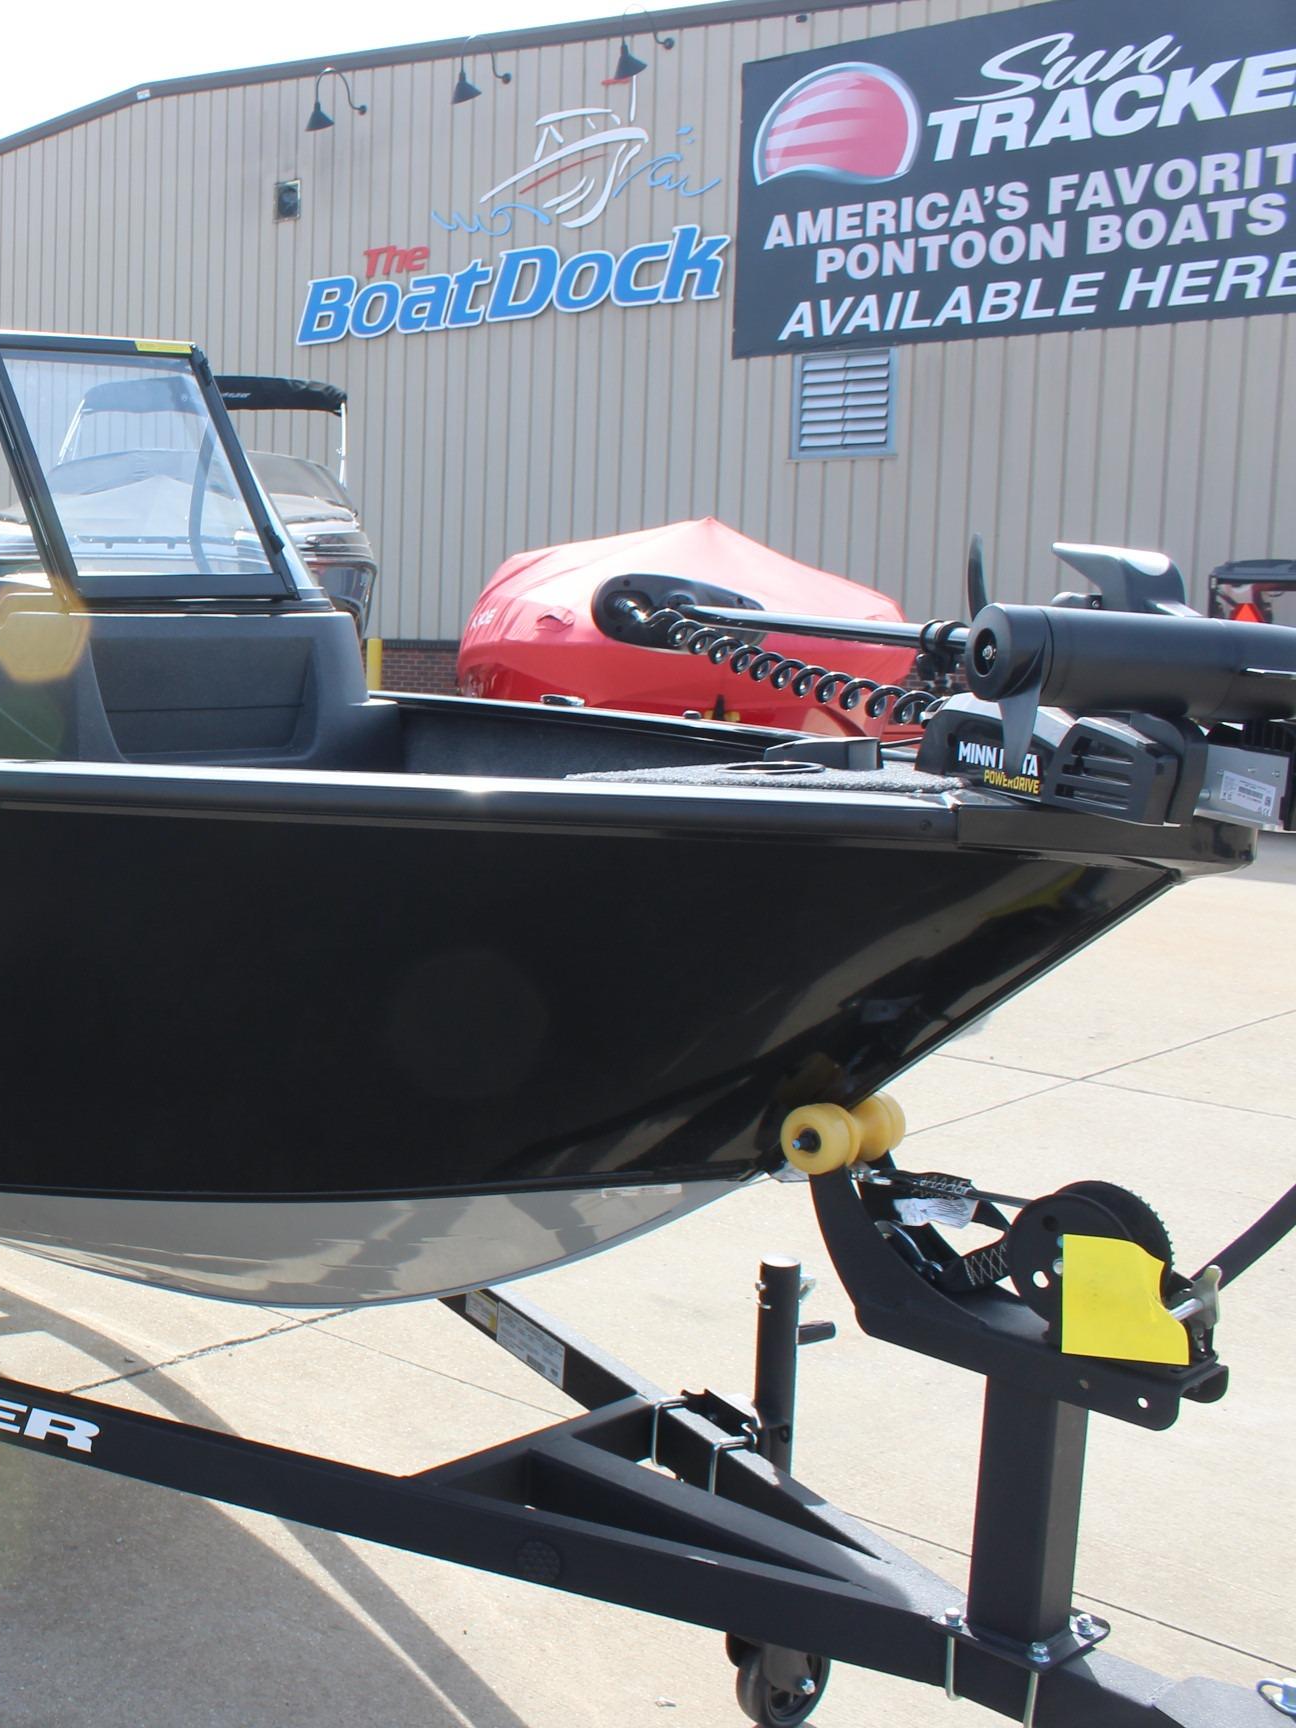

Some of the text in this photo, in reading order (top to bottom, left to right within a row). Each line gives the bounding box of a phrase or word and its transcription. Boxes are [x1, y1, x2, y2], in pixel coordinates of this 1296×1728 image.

[954, 32, 1183, 102] Sun
[926, 48, 1296, 162] TRACKE
[763, 181, 1029, 250] AMERICA'S
[816, 193, 1287, 285] PONTOON BOATS
[363, 245, 430, 278] The
[778, 251, 1296, 341] AVAILABLE HERE
[958, 741, 997, 768] MINN
